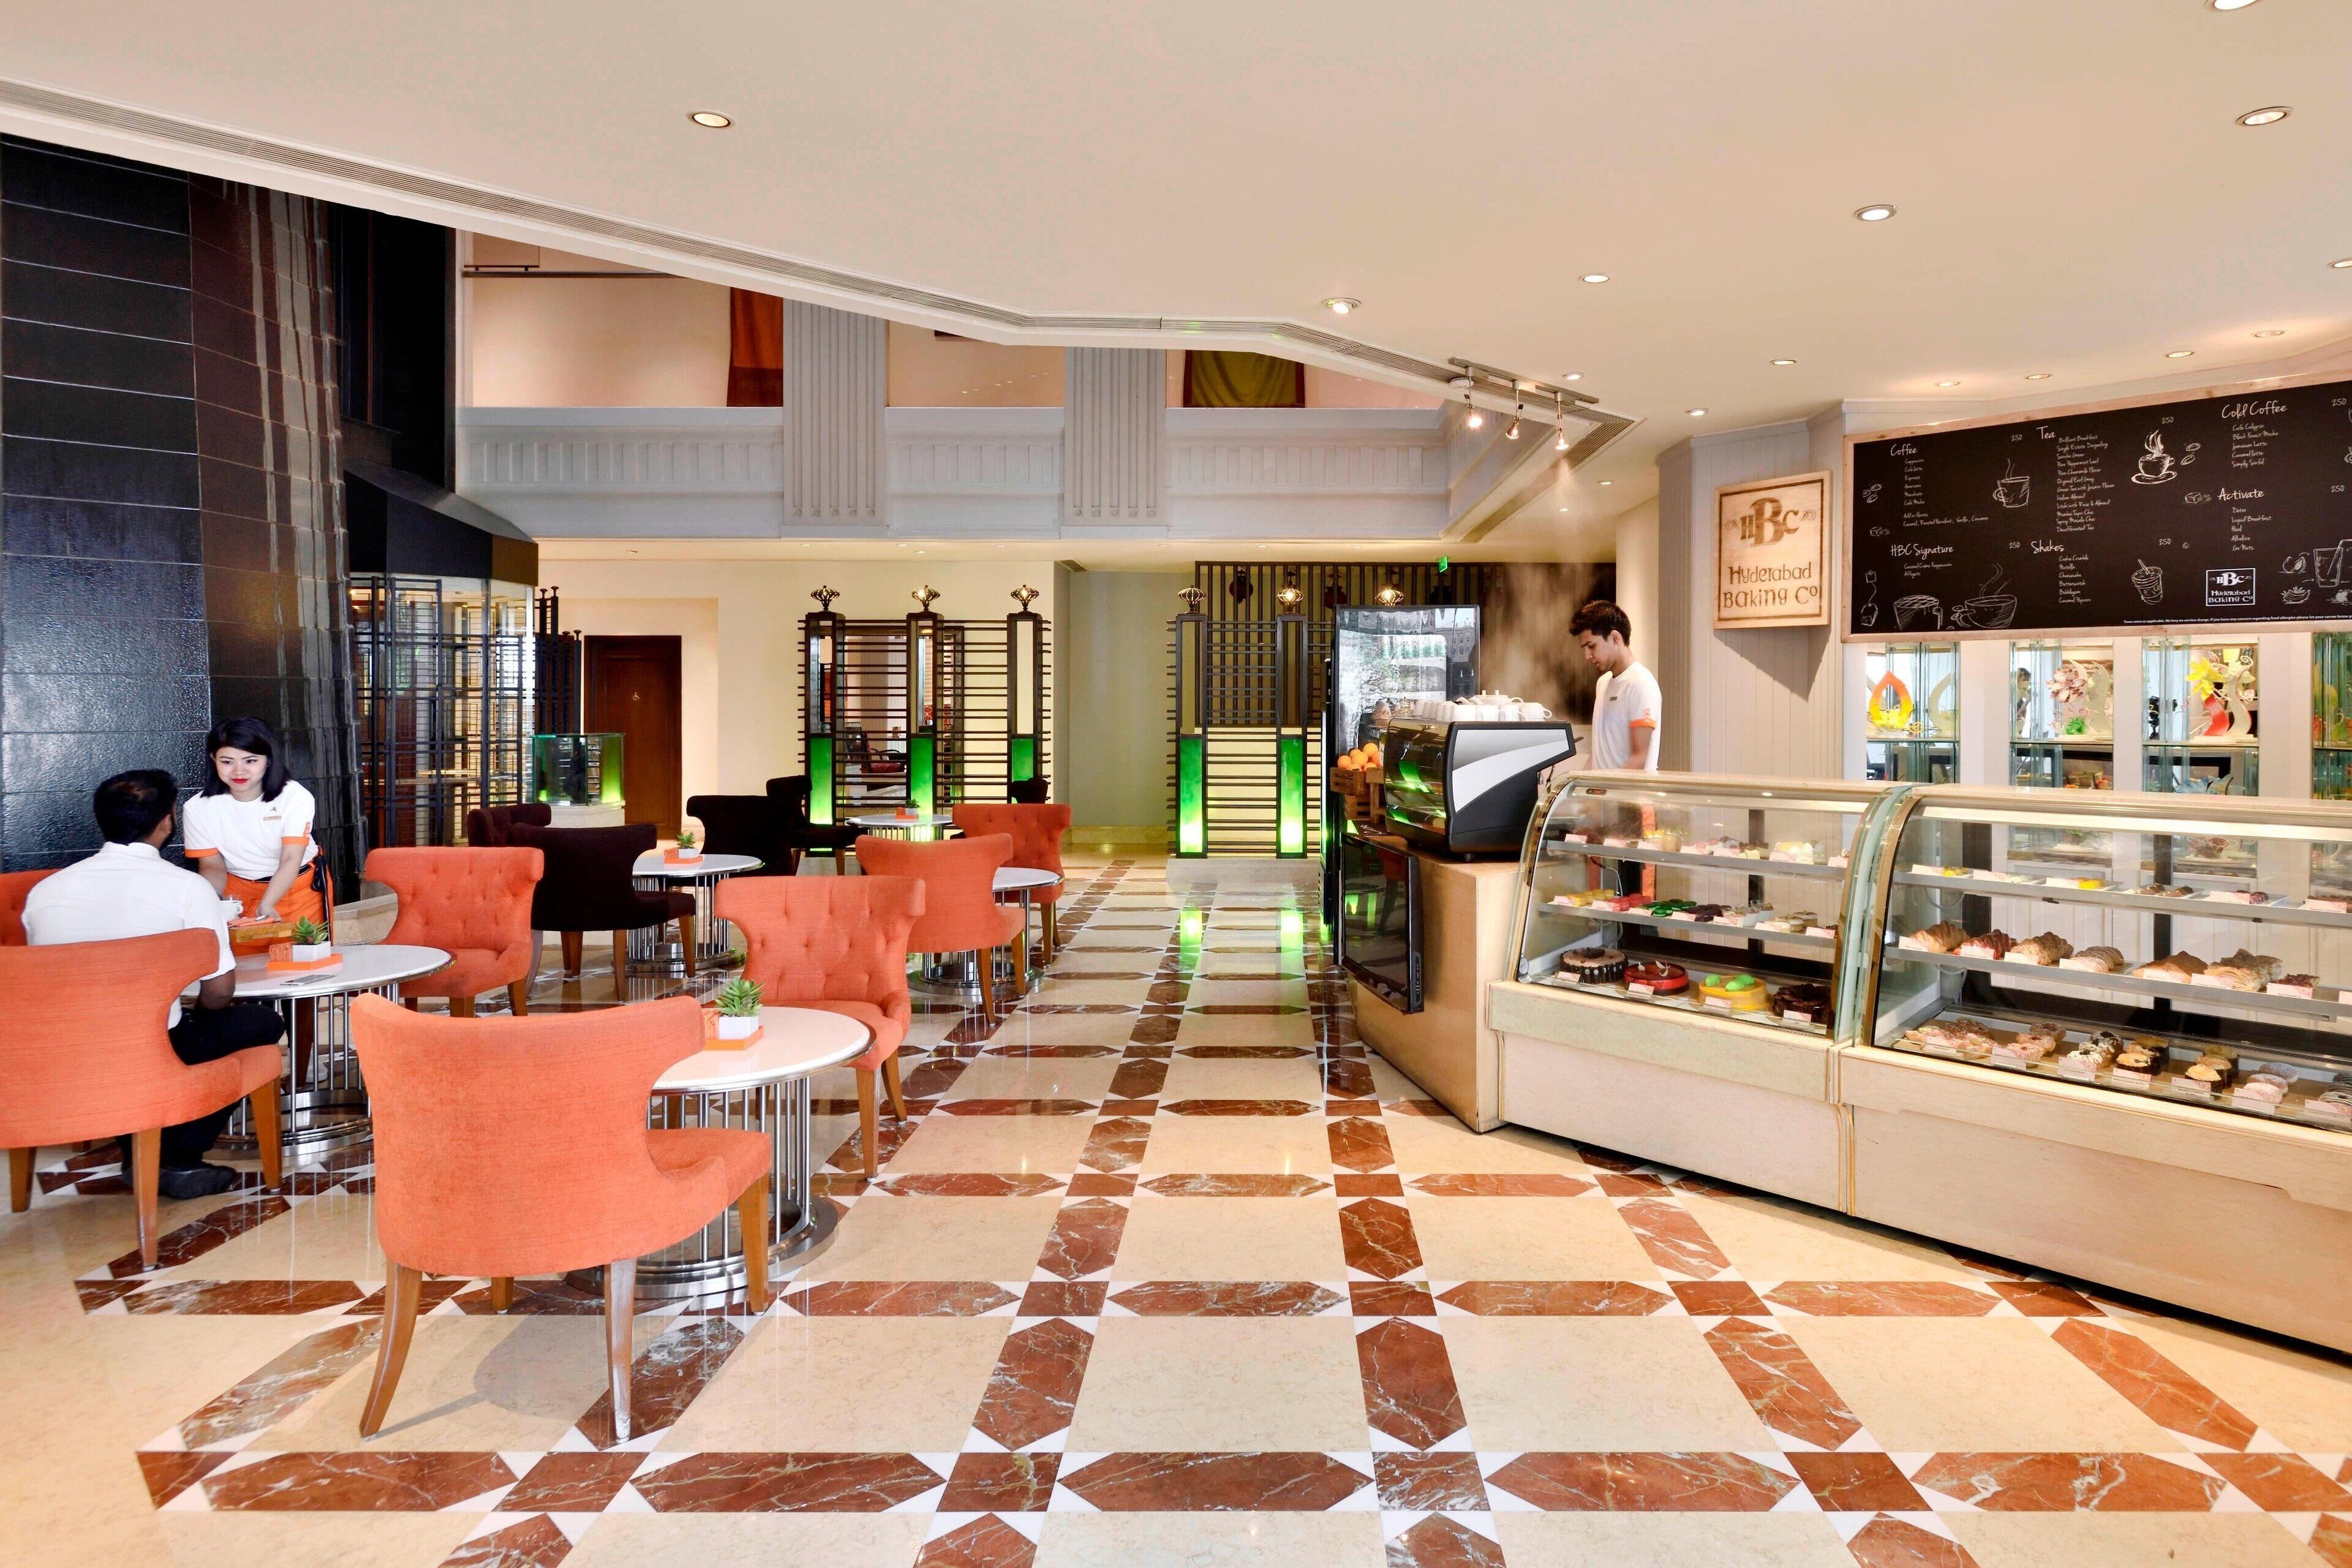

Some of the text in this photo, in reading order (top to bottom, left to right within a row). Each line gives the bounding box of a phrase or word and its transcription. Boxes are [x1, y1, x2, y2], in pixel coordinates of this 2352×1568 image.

[2222, 400, 2288, 419] Cold Coffee
[2332, 398, 2347, 407] 250
[2036, 426, 2056, 439] Tea
[1890, 443, 1918, 456] Coffee
[2218, 488, 2264, 501] Activate
[1740, 497, 1799, 547] HBC
[1891, 543, 1954, 560] HBC Signature
[2030, 540, 2065, 554] Shakes
[1728, 562, 1812, 585] Hyderabad
[2216, 571, 2245, 586] HBC
